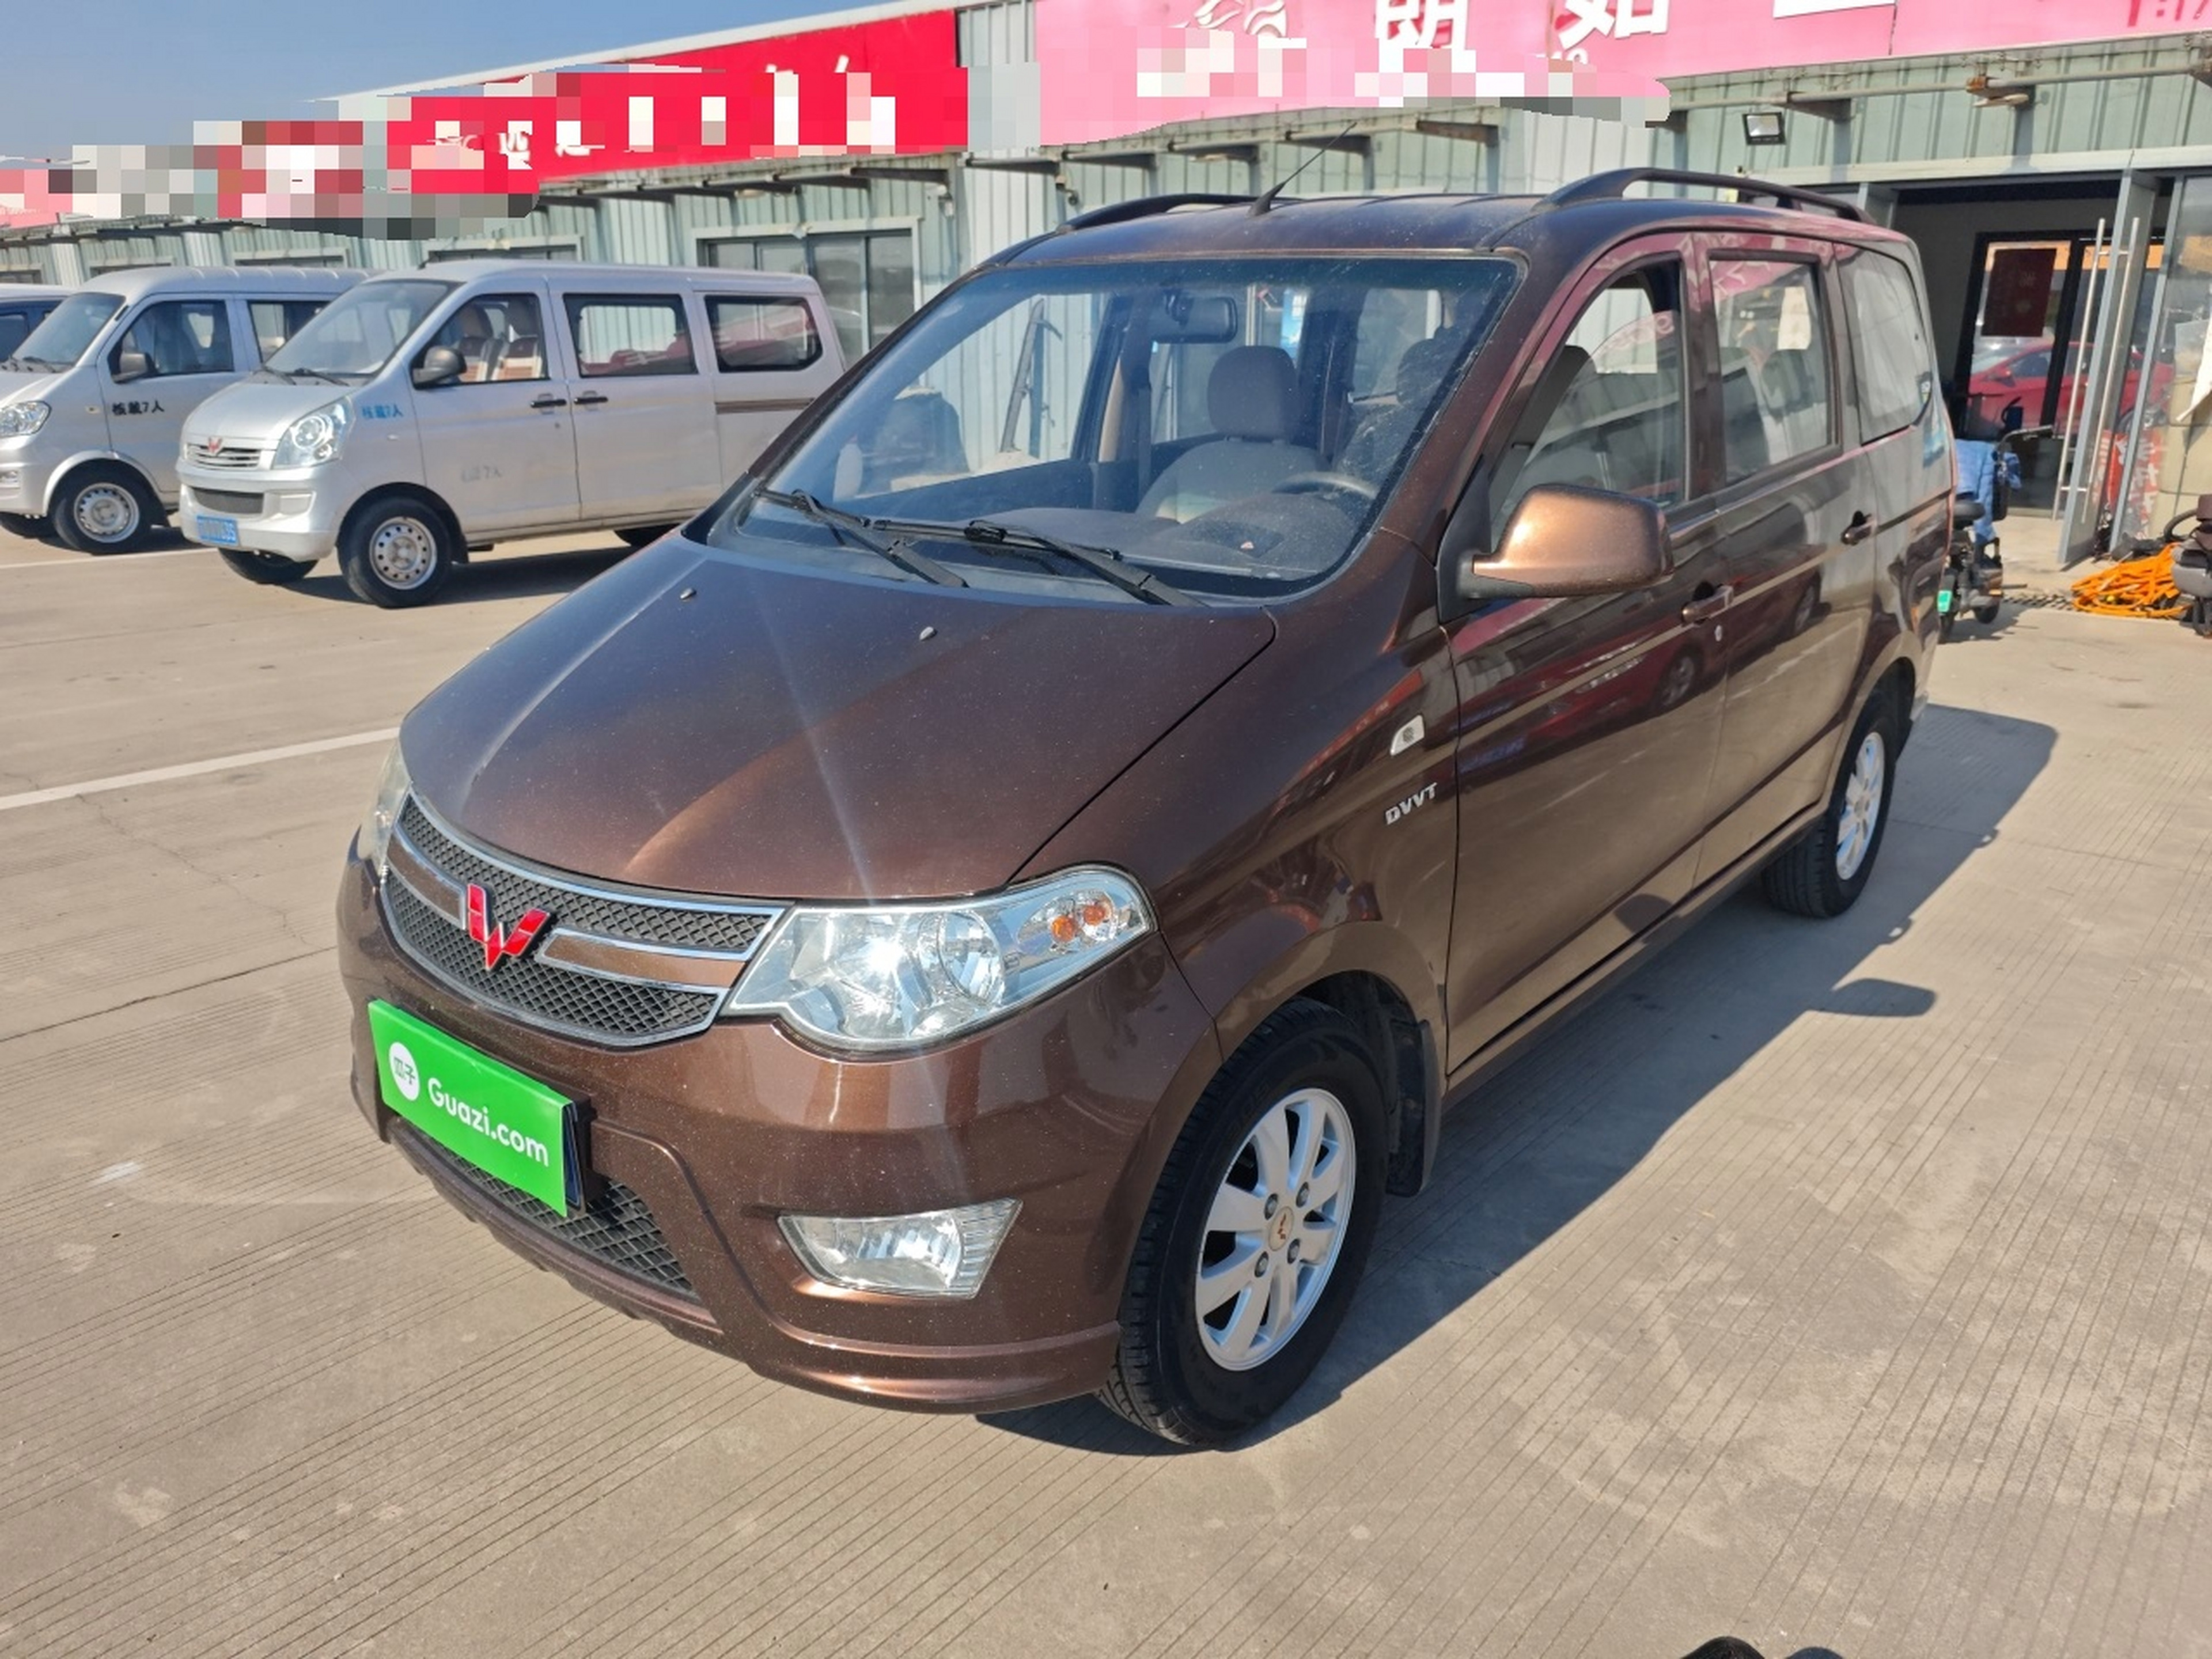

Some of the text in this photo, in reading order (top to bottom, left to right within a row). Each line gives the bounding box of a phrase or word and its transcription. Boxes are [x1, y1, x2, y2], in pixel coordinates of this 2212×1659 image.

[112, 399, 165, 416] 核载7人
[1385, 782, 1438, 825] DVVT
[393, 1056, 416, 1085] 瓜子
[427, 1077, 550, 1168] Guazi.com
